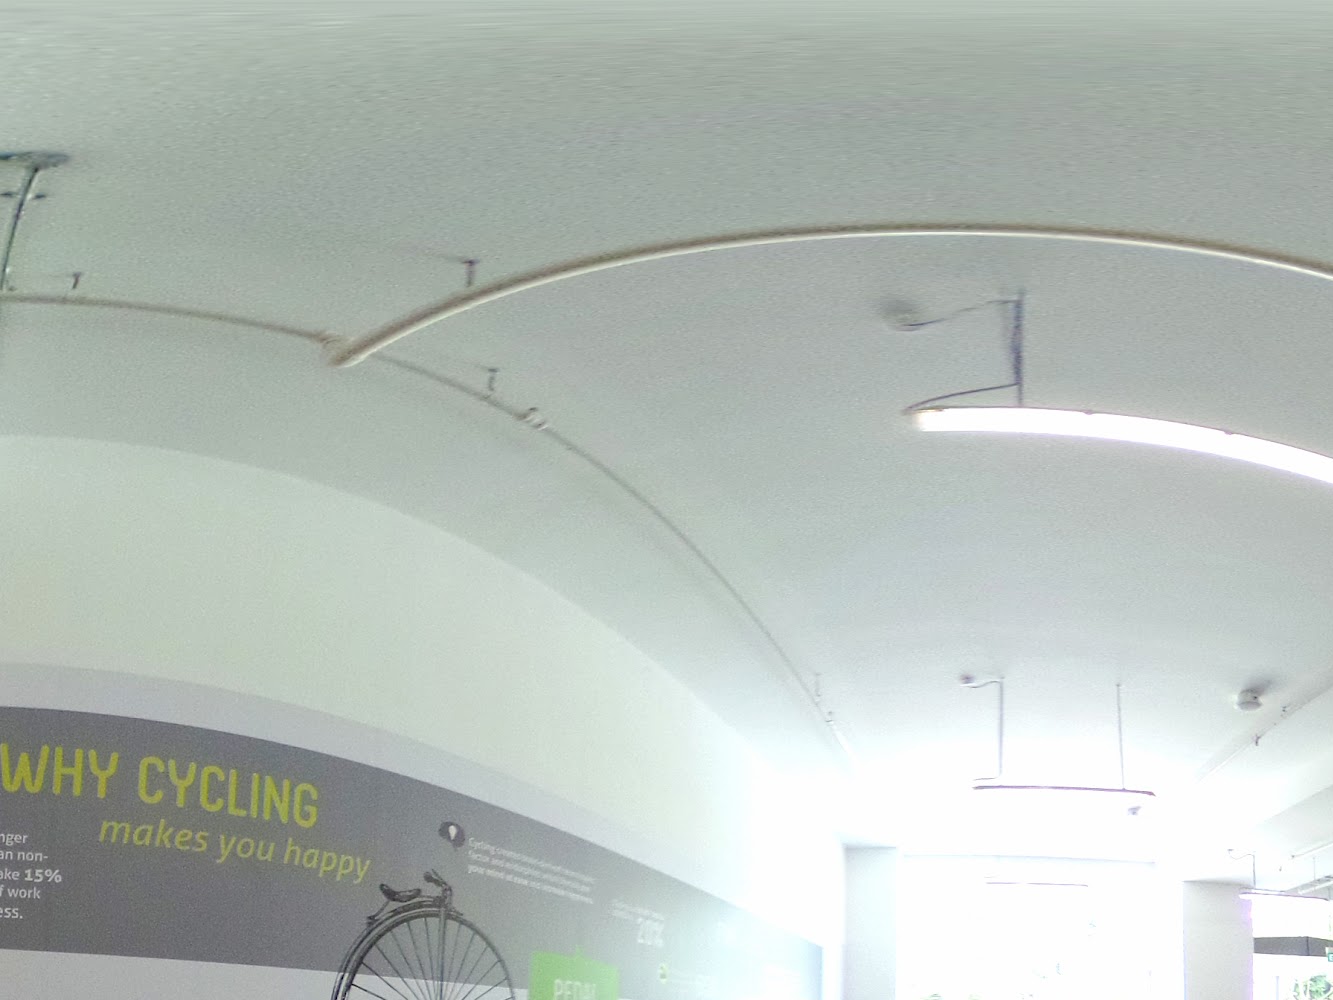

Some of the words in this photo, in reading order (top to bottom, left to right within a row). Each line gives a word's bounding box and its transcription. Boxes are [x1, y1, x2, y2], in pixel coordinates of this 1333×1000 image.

[0, 743, 119, 799] WHY
[138, 756, 319, 828] CYCLING
[17, 851, 48, 861] non-
[99, 819, 208, 852] makes
[216, 832, 275, 863] you
[283, 836, 372, 883] happy
[24, 868, 62, 883] 15%
[7, 886, 41, 899] work
